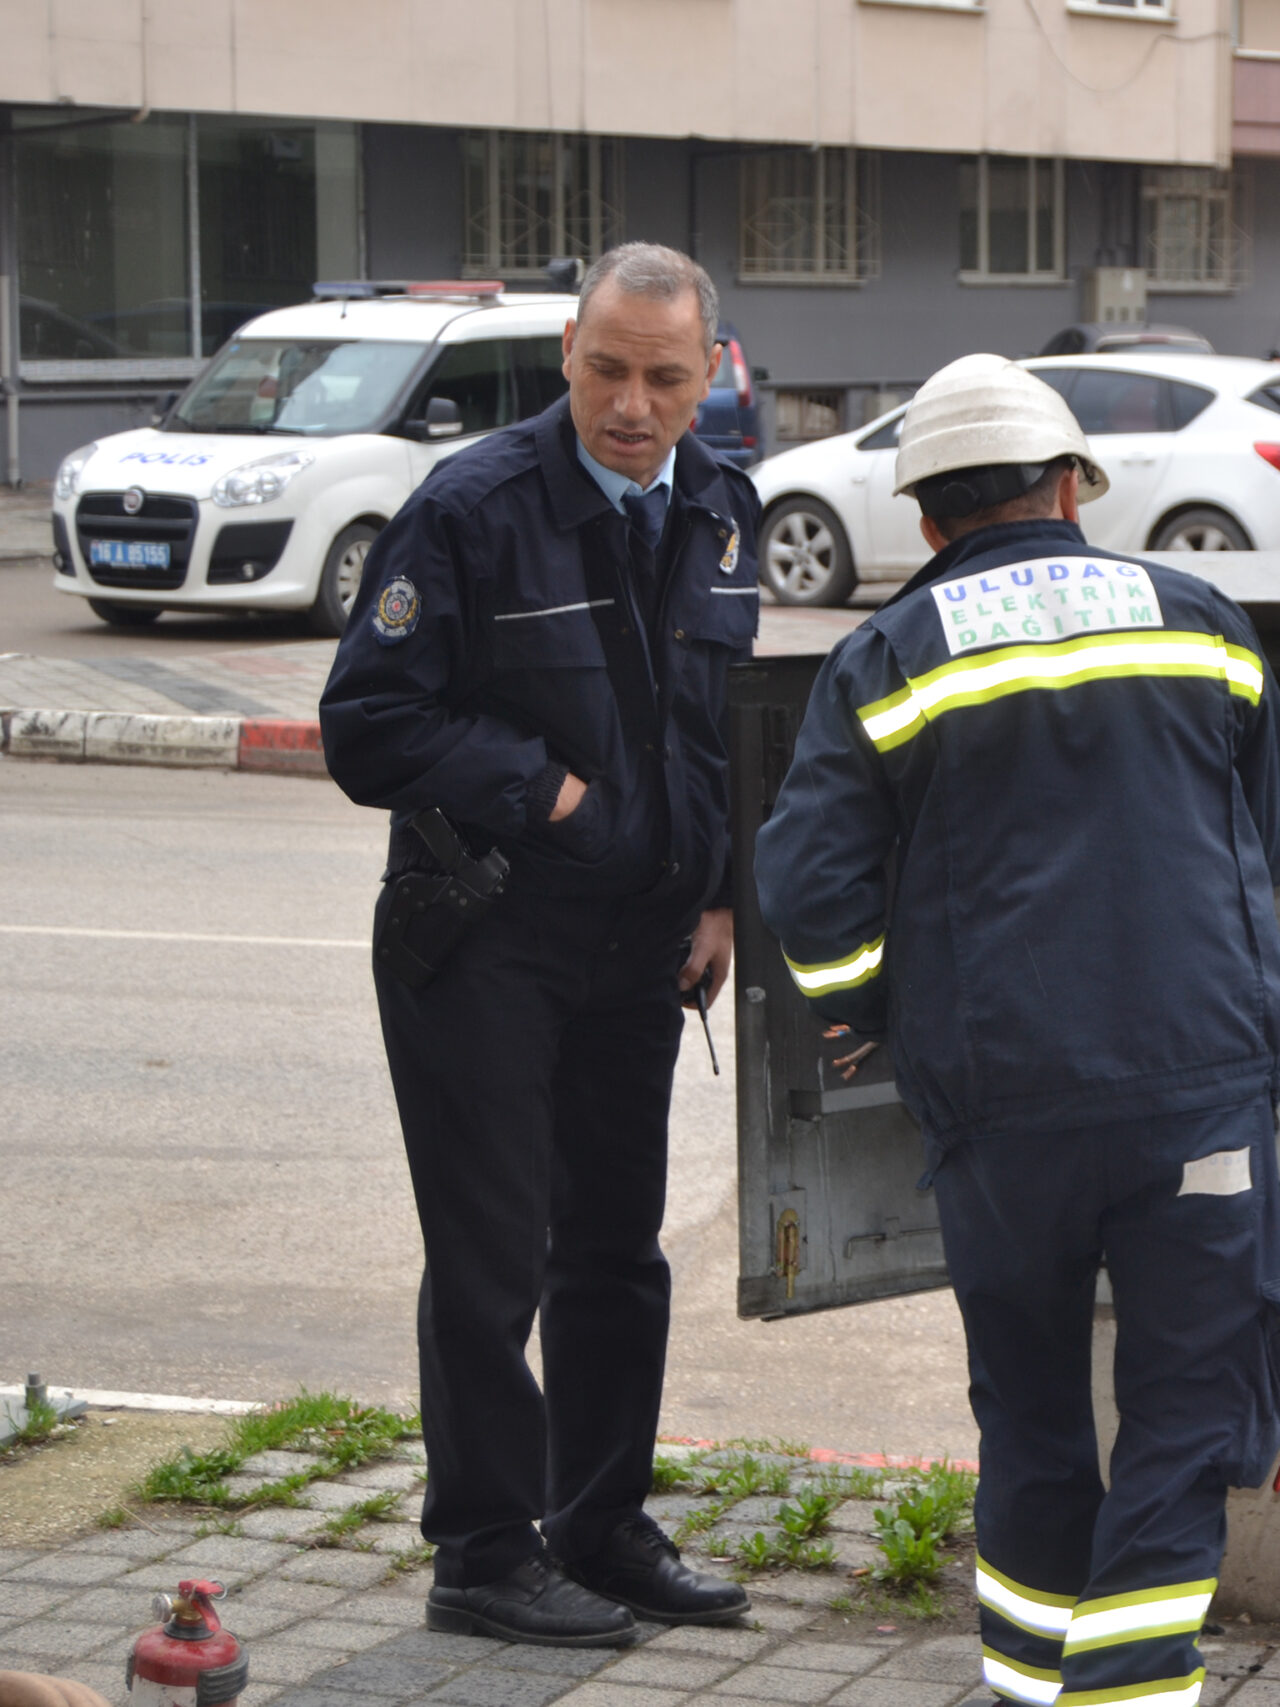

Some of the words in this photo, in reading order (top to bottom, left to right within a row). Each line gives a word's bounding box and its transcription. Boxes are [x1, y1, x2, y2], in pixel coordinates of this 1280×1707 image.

[115, 545, 124, 561] A
[943, 563, 1138, 602] ULUDAĞ
[951, 581, 1147, 625] ELEKTRİK
[958, 605, 1154, 647] DAĞITIM
